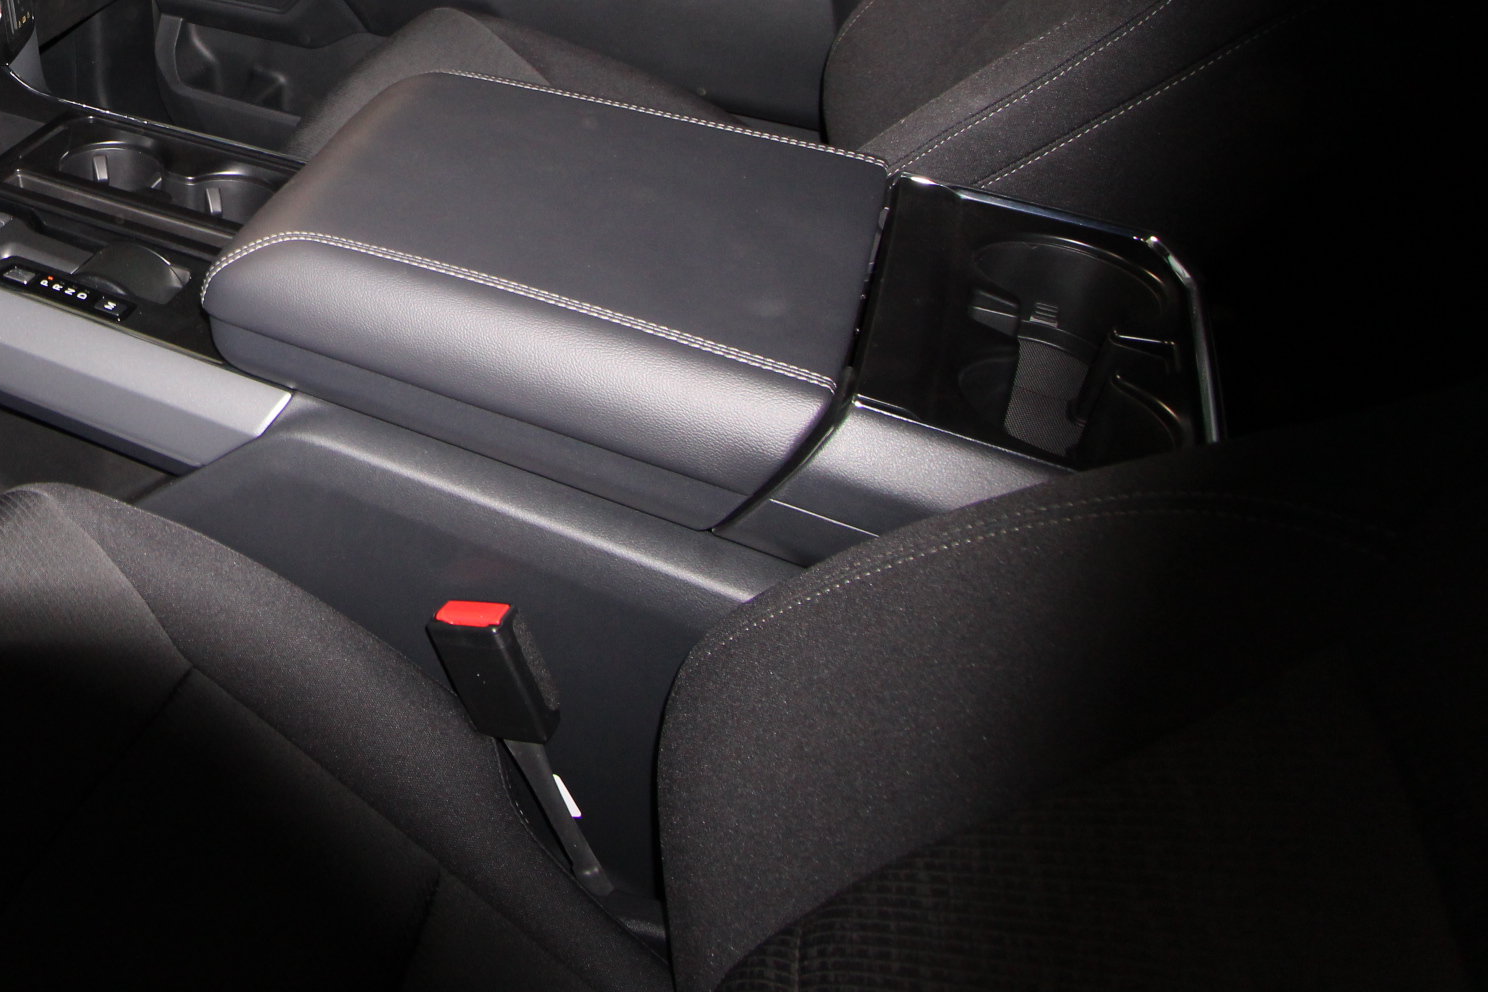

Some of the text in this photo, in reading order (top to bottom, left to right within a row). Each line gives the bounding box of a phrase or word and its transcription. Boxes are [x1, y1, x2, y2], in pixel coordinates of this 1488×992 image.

[40, 279, 49, 287] P
[77, 292, 88, 300] D
[104, 301, 116, 310] M
